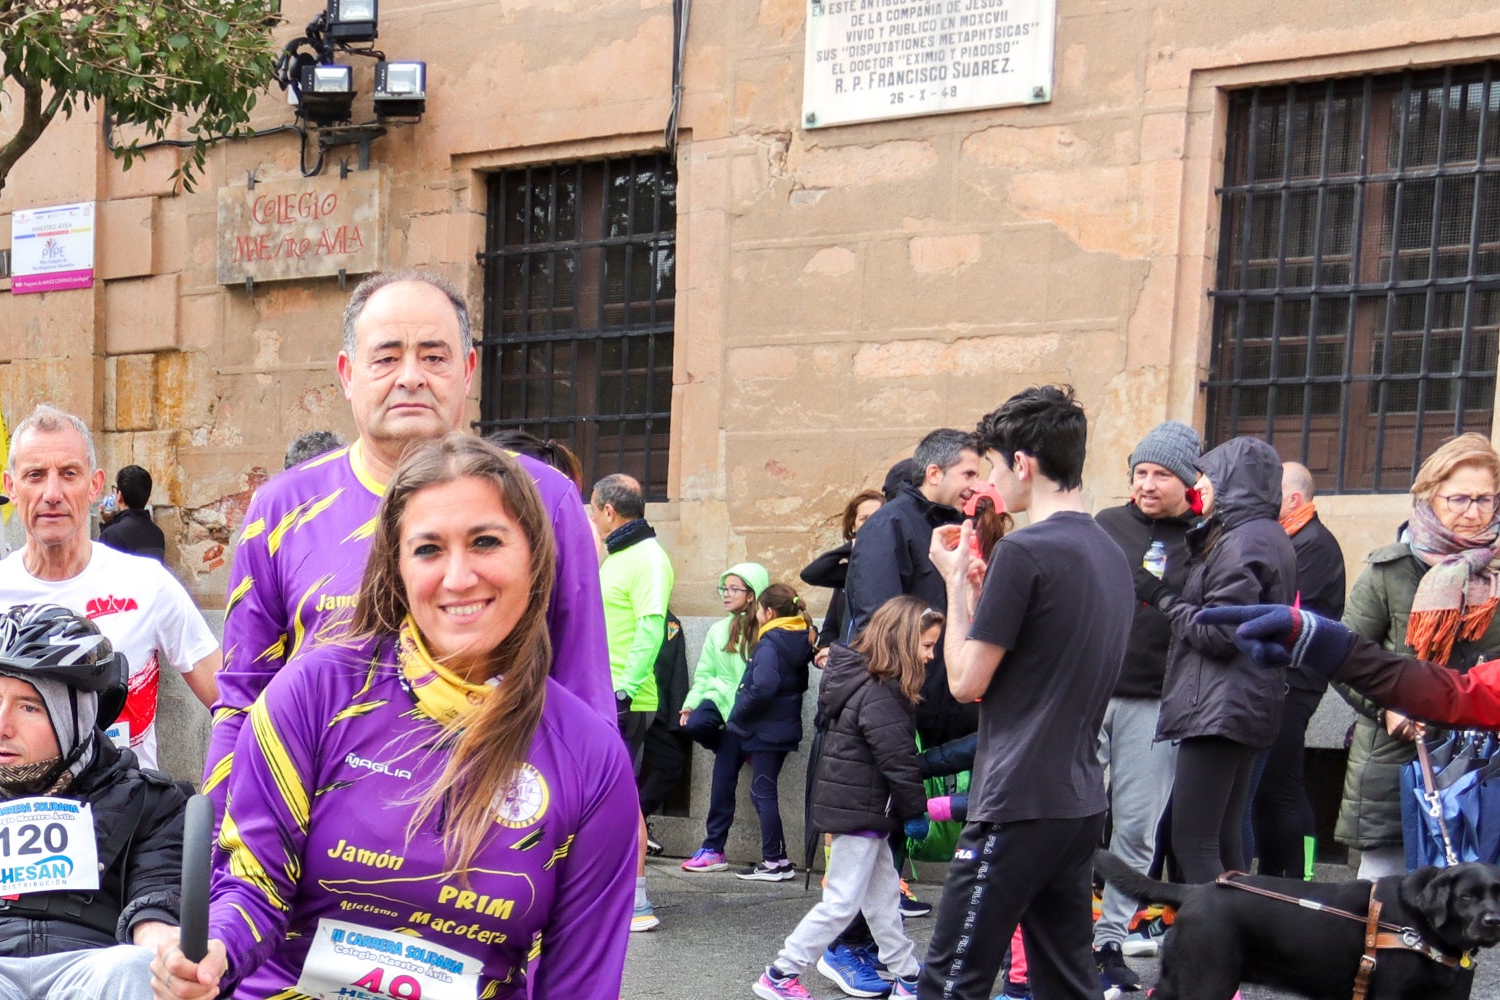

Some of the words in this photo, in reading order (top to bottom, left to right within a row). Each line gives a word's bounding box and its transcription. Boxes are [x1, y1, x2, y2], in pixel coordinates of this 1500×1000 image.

[828, 1, 856, 14] ESTE
[851, 14, 865, 27] DE
[868, 12, 882, 24] LA
[947, 1, 961, 14] DE
[846, 28, 874, 42] VIVIO
[879, 27, 885, 38] Y
[889, 20, 937, 37] PUBLICO
[941, 17, 955, 30] EN
[816, 48, 837, 62] SUS
[831, 63, 845, 75] EL
[850, 56, 893, 73] DOCTOR
[950, 48, 956, 60] Y
[835, 78, 847, 94] R.
[853, 76, 863, 92] P.
[868, 65, 947, 89] FRANCISCO
[953, 57, 1014, 79] SUAREZ.
[327, 839, 404, 870] Jamón
[1, 863, 66, 884] HESAN
[438, 885, 514, 920] PRIM
[340, 900, 399, 918] Atletismo
[409, 911, 507, 944] Macotera
[334, 945, 376, 961] Colegio
[378, 954, 424, 975] Maestro
[425, 965, 453, 983] Ávila
[346, 932, 402, 956] CARRERA
[405, 946, 464, 975] SOLIDARIA
